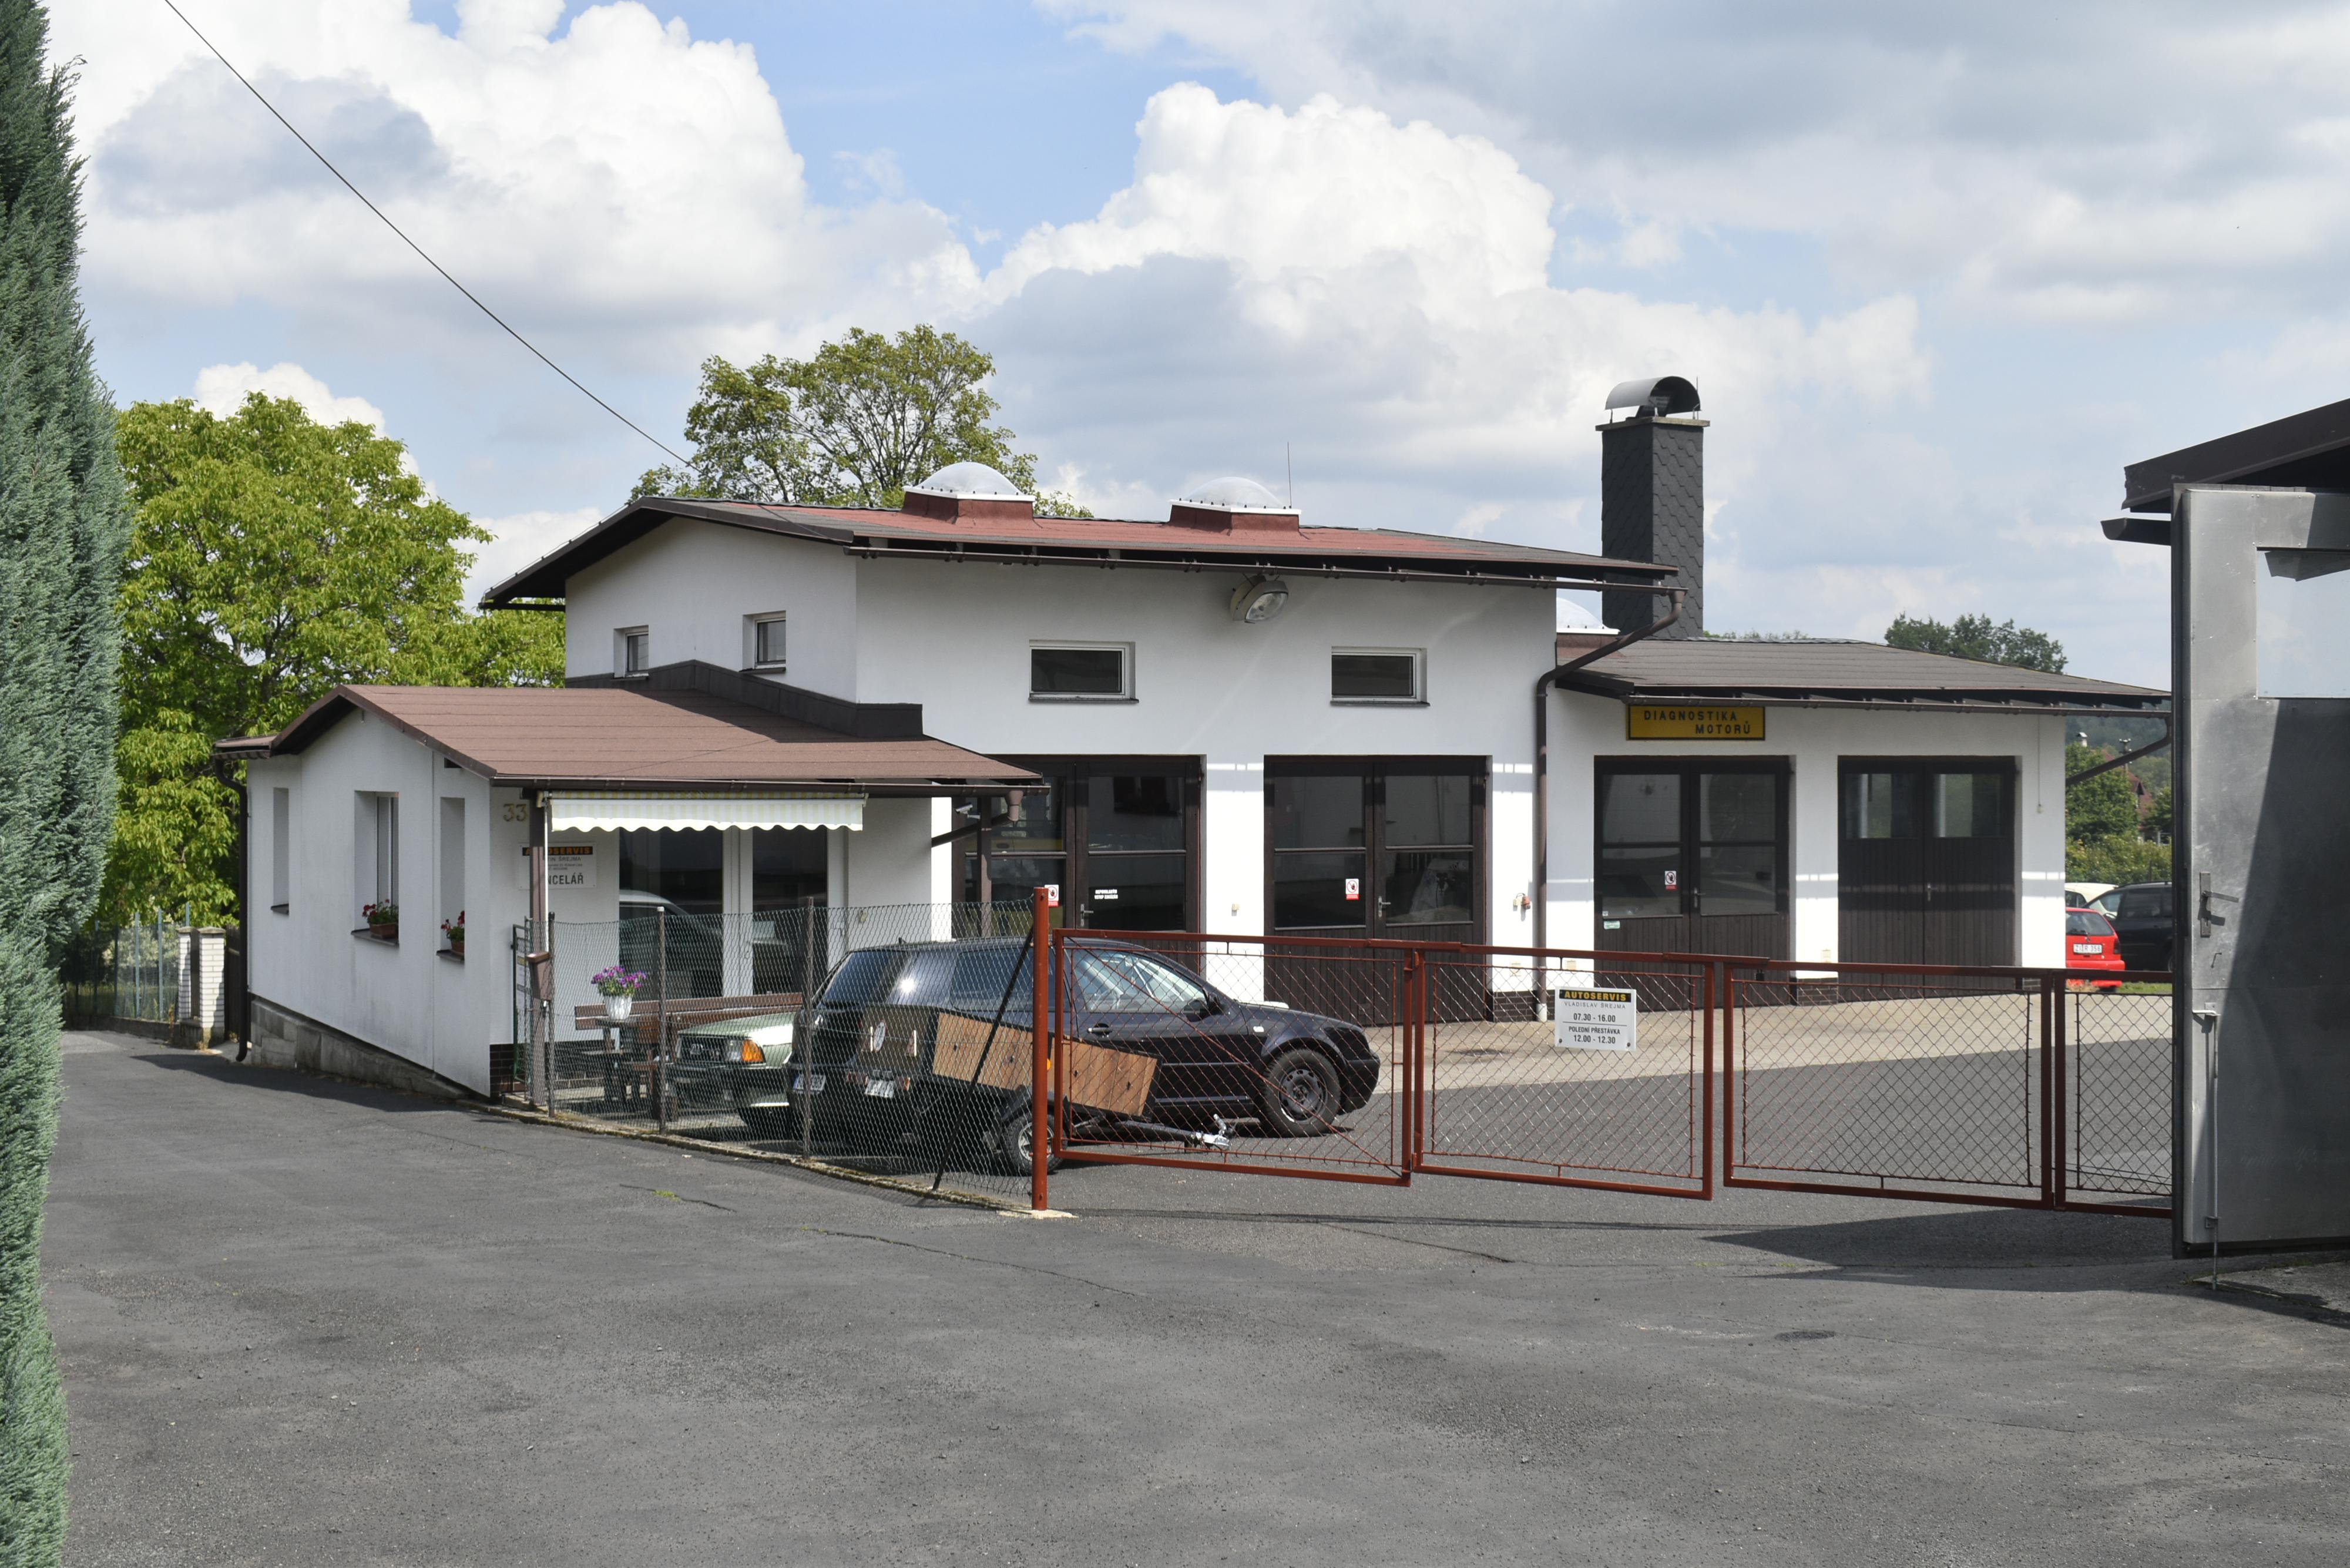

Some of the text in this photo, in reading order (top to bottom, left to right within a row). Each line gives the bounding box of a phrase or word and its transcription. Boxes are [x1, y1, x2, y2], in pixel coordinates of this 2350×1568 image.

[1643, 710, 1737, 721] DIAGNOSTIKA
[1695, 721, 1751, 734] MOTORŮ
[503, 803, 527, 822] 33
[1564, 991, 1627, 1001] AUTOSERVIS
[1573, 1013, 1591, 1021] 07.30
[1591, 1026, 1620, 1035] PŘESTÁVKA
[1573, 1035, 1591, 1043] 12.00
[1598, 1036, 1616, 1044] 12.30
